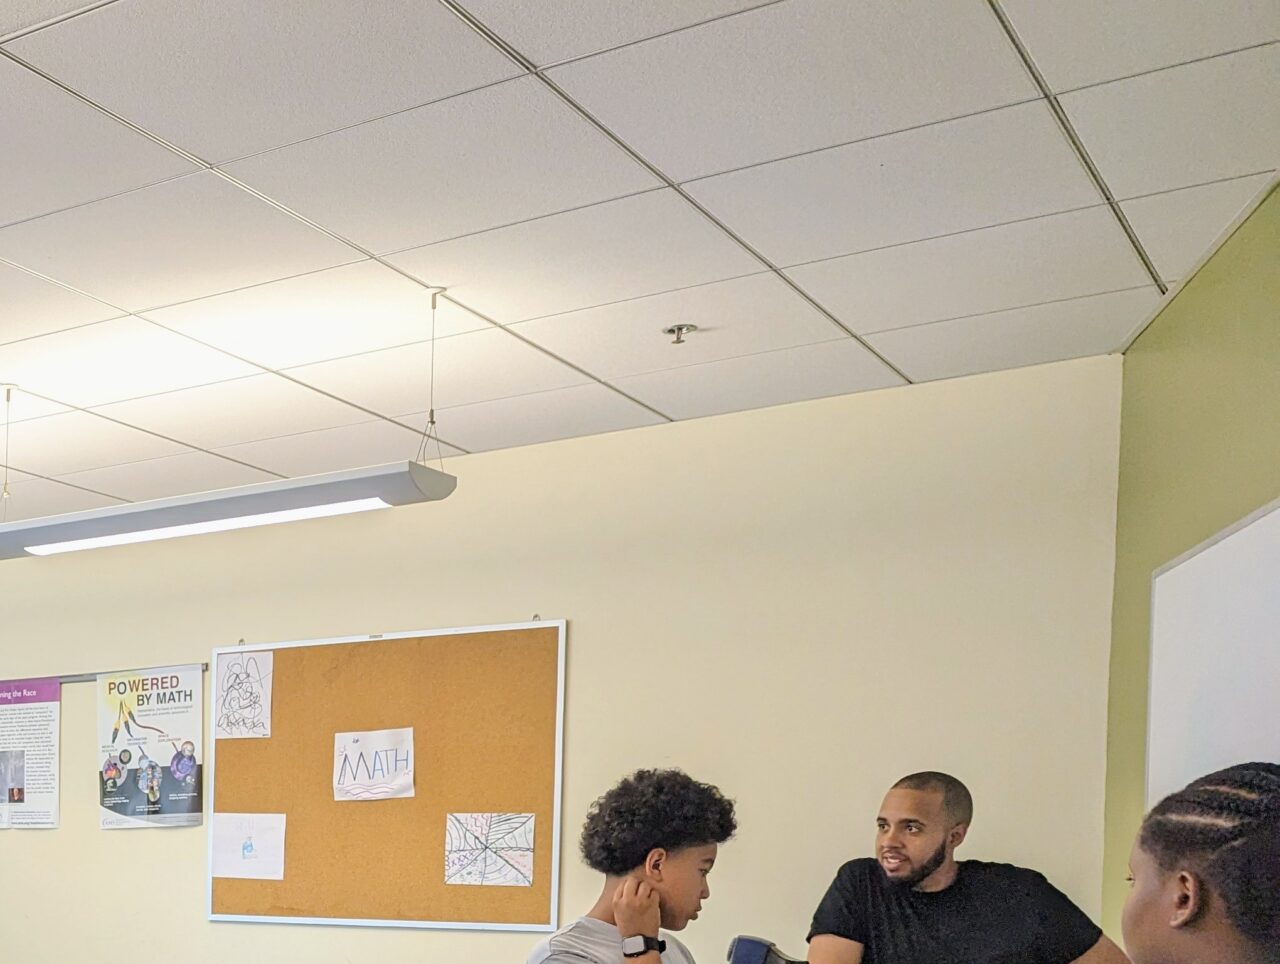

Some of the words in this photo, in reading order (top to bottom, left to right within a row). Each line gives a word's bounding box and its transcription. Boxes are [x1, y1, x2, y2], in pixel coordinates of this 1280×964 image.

[23, 688, 37, 697] Race
[108, 675, 180, 695] POWERED
[136, 693, 152, 707] BY
[156, 689, 193, 705] MATH
[337, 747, 409, 786] MATH
